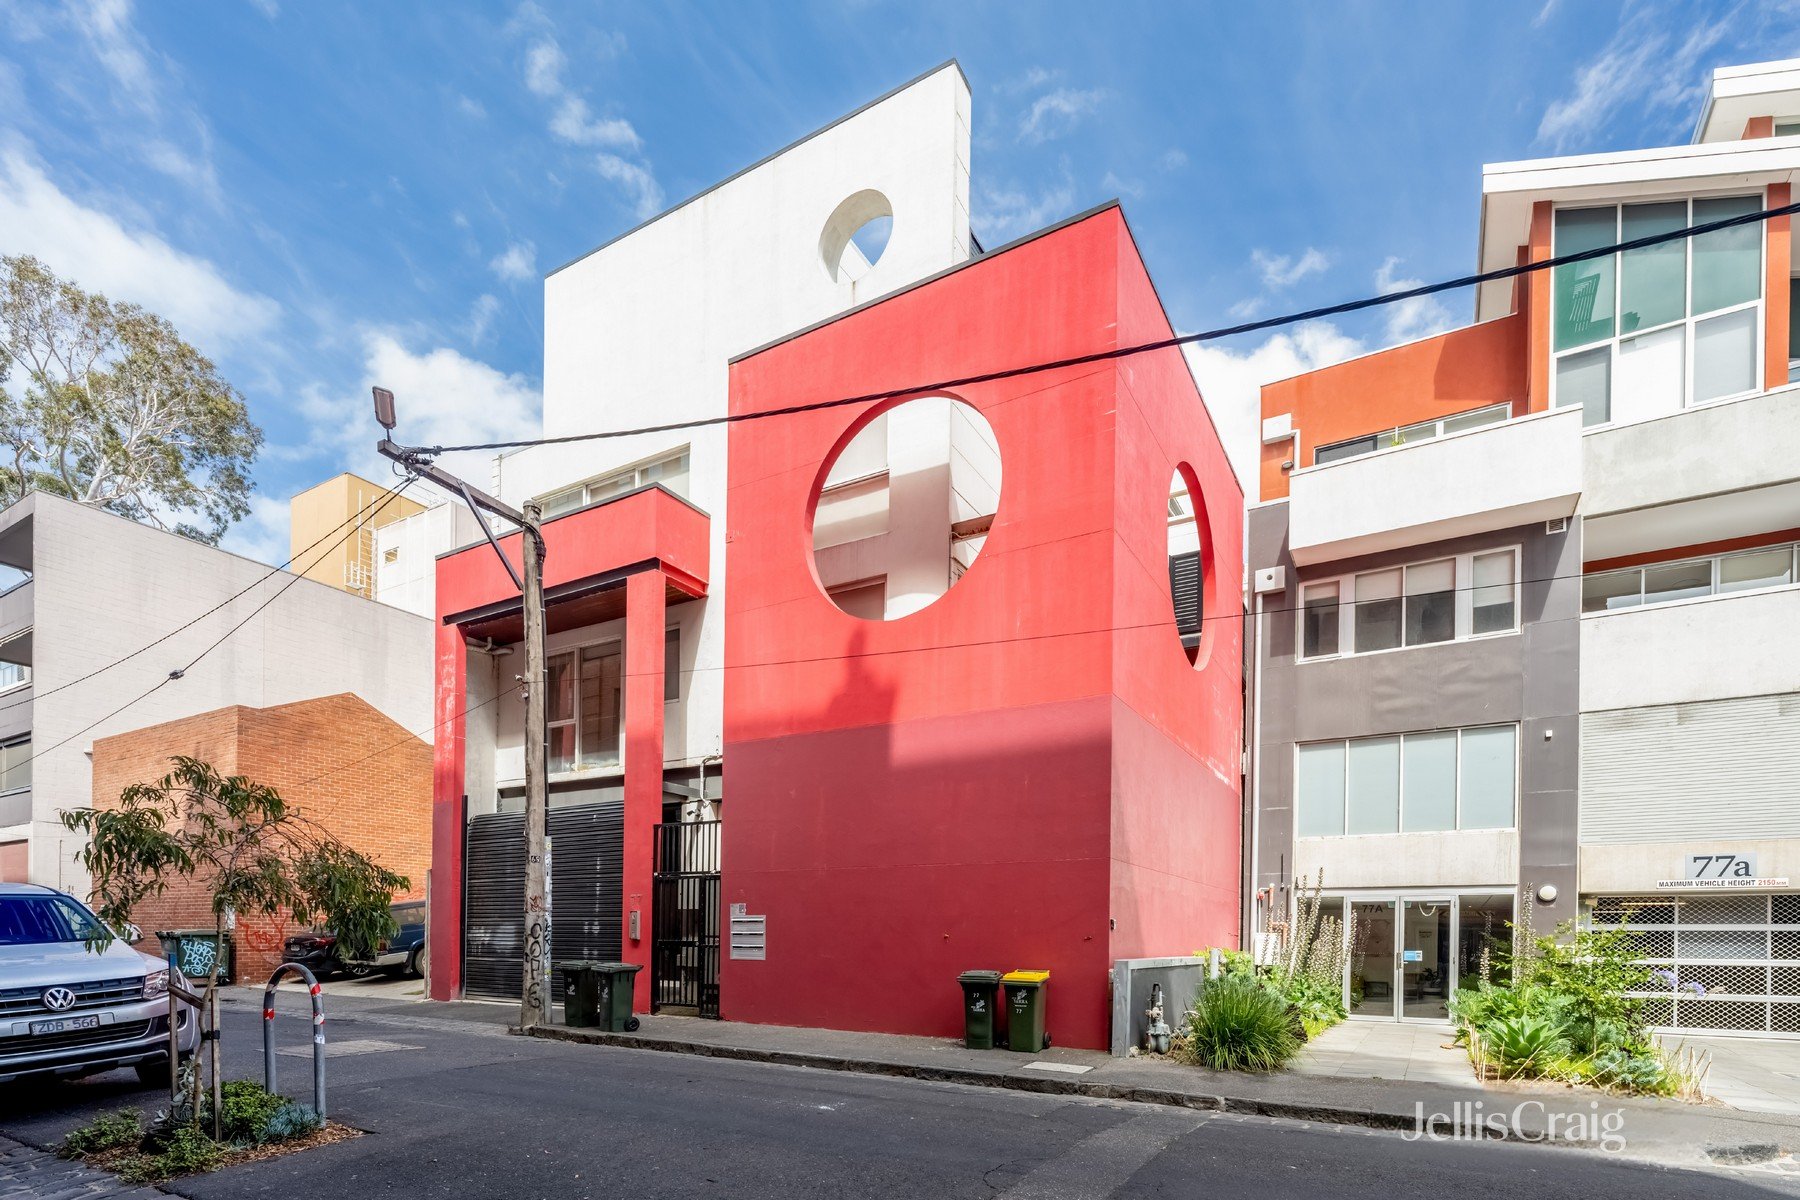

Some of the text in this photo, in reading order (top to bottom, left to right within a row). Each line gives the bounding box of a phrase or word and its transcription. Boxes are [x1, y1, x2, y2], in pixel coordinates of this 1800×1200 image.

[1693, 855, 1752, 878] 77a
[1658, 880, 1693, 888] MAXIMUM
[1362, 905, 1383, 913] 77A
